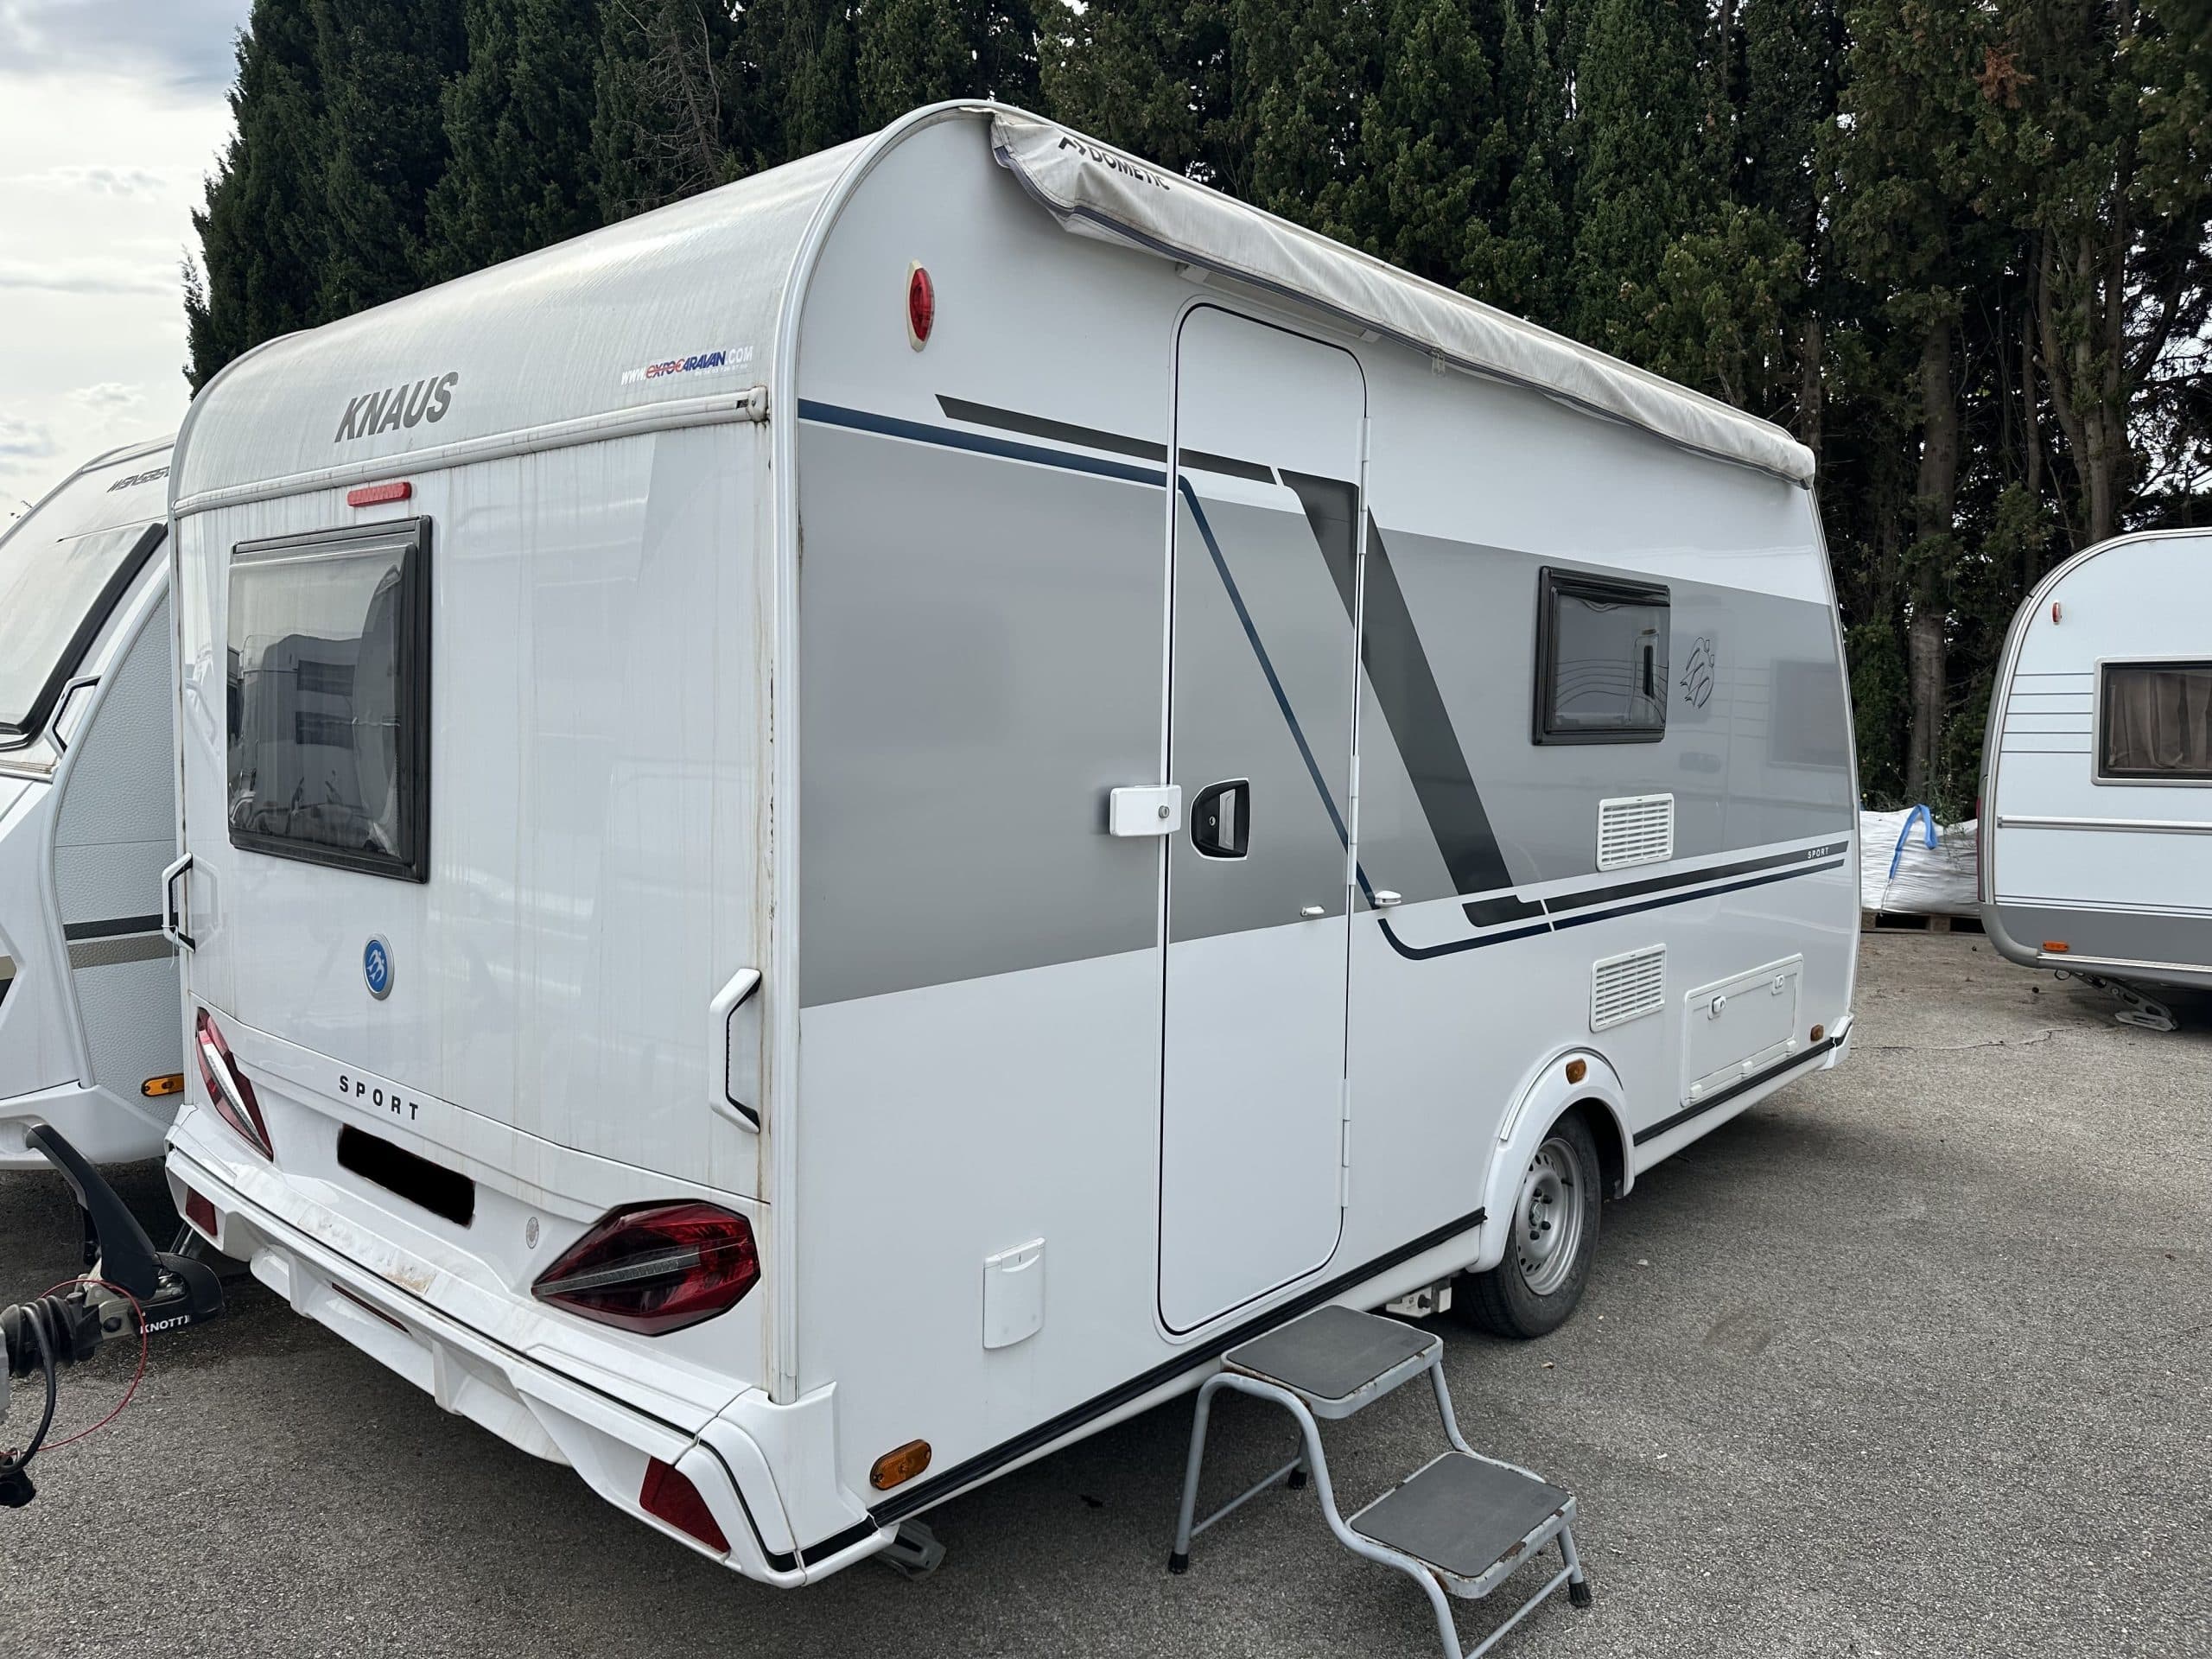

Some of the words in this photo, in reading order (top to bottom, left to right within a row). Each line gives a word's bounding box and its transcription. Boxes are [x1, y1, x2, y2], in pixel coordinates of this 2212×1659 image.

[1087, 146, 1171, 191] DOMETIC
[334, 372, 459, 443] KNAUS
[1807, 847, 1830, 860] SPORT
[339, 1075, 419, 1121] SPORT
[140, 1315, 184, 1334] KNOTT
